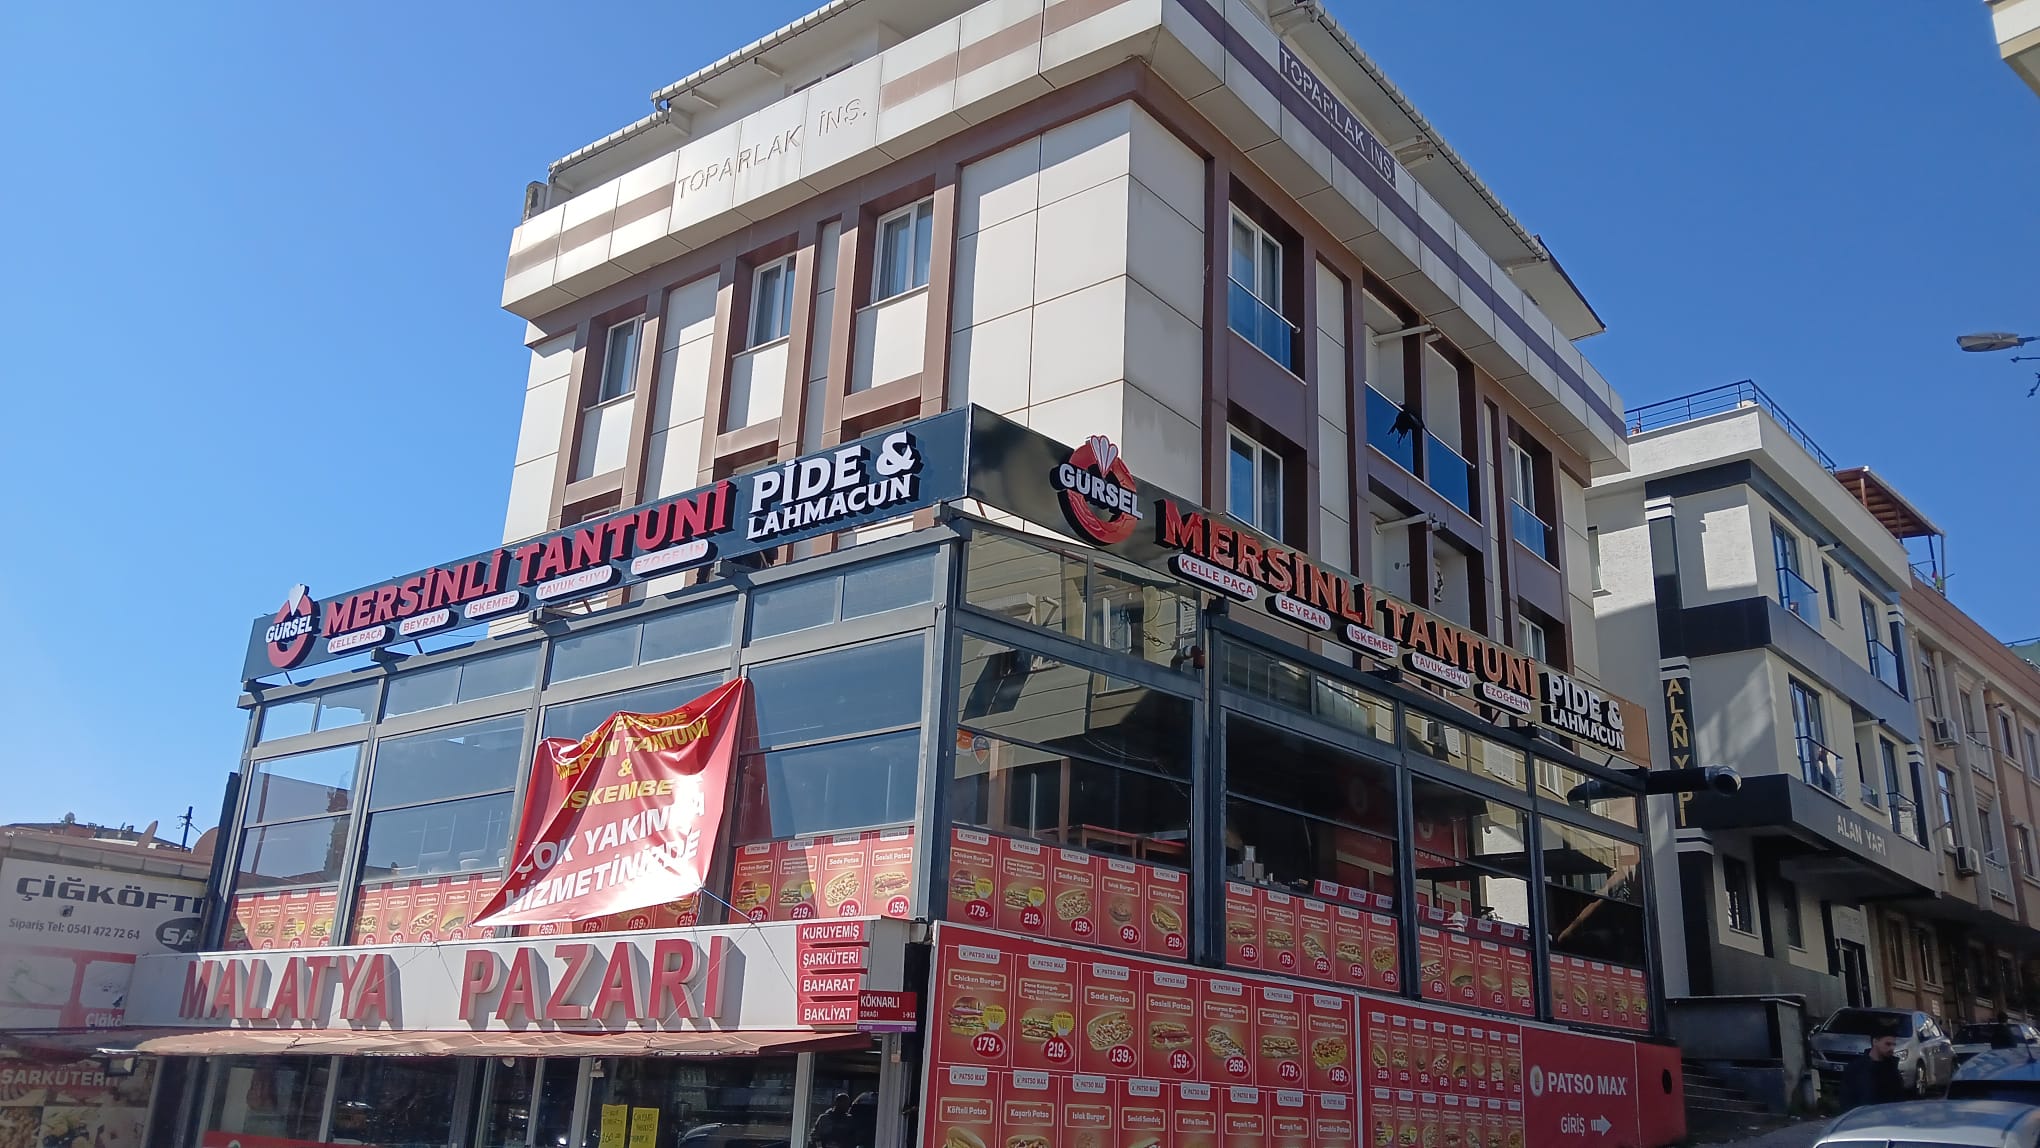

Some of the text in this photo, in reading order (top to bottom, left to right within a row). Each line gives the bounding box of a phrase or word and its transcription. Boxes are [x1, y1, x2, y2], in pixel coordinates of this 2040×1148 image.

[1280, 47, 1365, 152] TOPARLAK
[678, 125, 802, 199] TOPARLAK
[749, 430, 915, 514] PİDE &
[1059, 463, 1143, 520] GÜRSEL
[746, 473, 913, 540] LAHMACUN
[322, 480, 730, 637] MERSİNLİ TANTUNİ
[539, 567, 609, 596] TAVUK SUYU
[1181, 559, 1255, 597] KELLE PAÇA
[1162, 499, 1537, 699] MERSİNLİ TANTUNİ
[403, 613, 445, 632] BEYRAN
[1280, 600, 1327, 626] BEYRAN
[265, 616, 313, 643] GÜRSEL
[329, 635, 357, 651] KELLE
[1413, 655, 1443, 676] TAVUK
[1550, 672, 1624, 732] PİDE &
[624, 715, 710, 753] TANTUNİ
[1550, 708, 1626, 751] LAHMACUN
[1666, 677, 1693, 827] ALAN YPI
[618, 759, 633, 778] &
[1837, 815, 1862, 845] ALAN
[66, 923, 91, 936] 0541
[93, 925, 112, 938] 472
[113, 927, 125, 938] 72
[127, 929, 140, 940] 64
[802, 924, 860, 941] KURUYEMİŞ
[802, 949, 859, 967] ŞARKÜTERİ
[968, 951, 985, 959] PATSO
[1037, 959, 1053, 967] PATSO
[180, 936, 730, 1021] MALATYA PAZARI
[803, 978, 855, 992] BAHARAT
[953, 974, 1002, 987] Chicken Burger
[860, 994, 900, 1009] KÖKNARLI
[1090, 991, 1130, 1004] Sade Patso
[1172, 1001, 1191, 1011] Patso
[804, 1004, 852, 1021] BAKLİYAT
[959, 1073, 975, 1081] PATSO
[1021, 1077, 1036, 1085] PATSO
[1548, 1071, 1627, 1096] PATSO MAX
[968, 1107, 987, 1116] Patso
[1032, 1110, 1049, 1119] Patso
[1086, 1113, 1105, 1122] Burger
[1561, 1113, 1585, 1136] GİRİŞ
